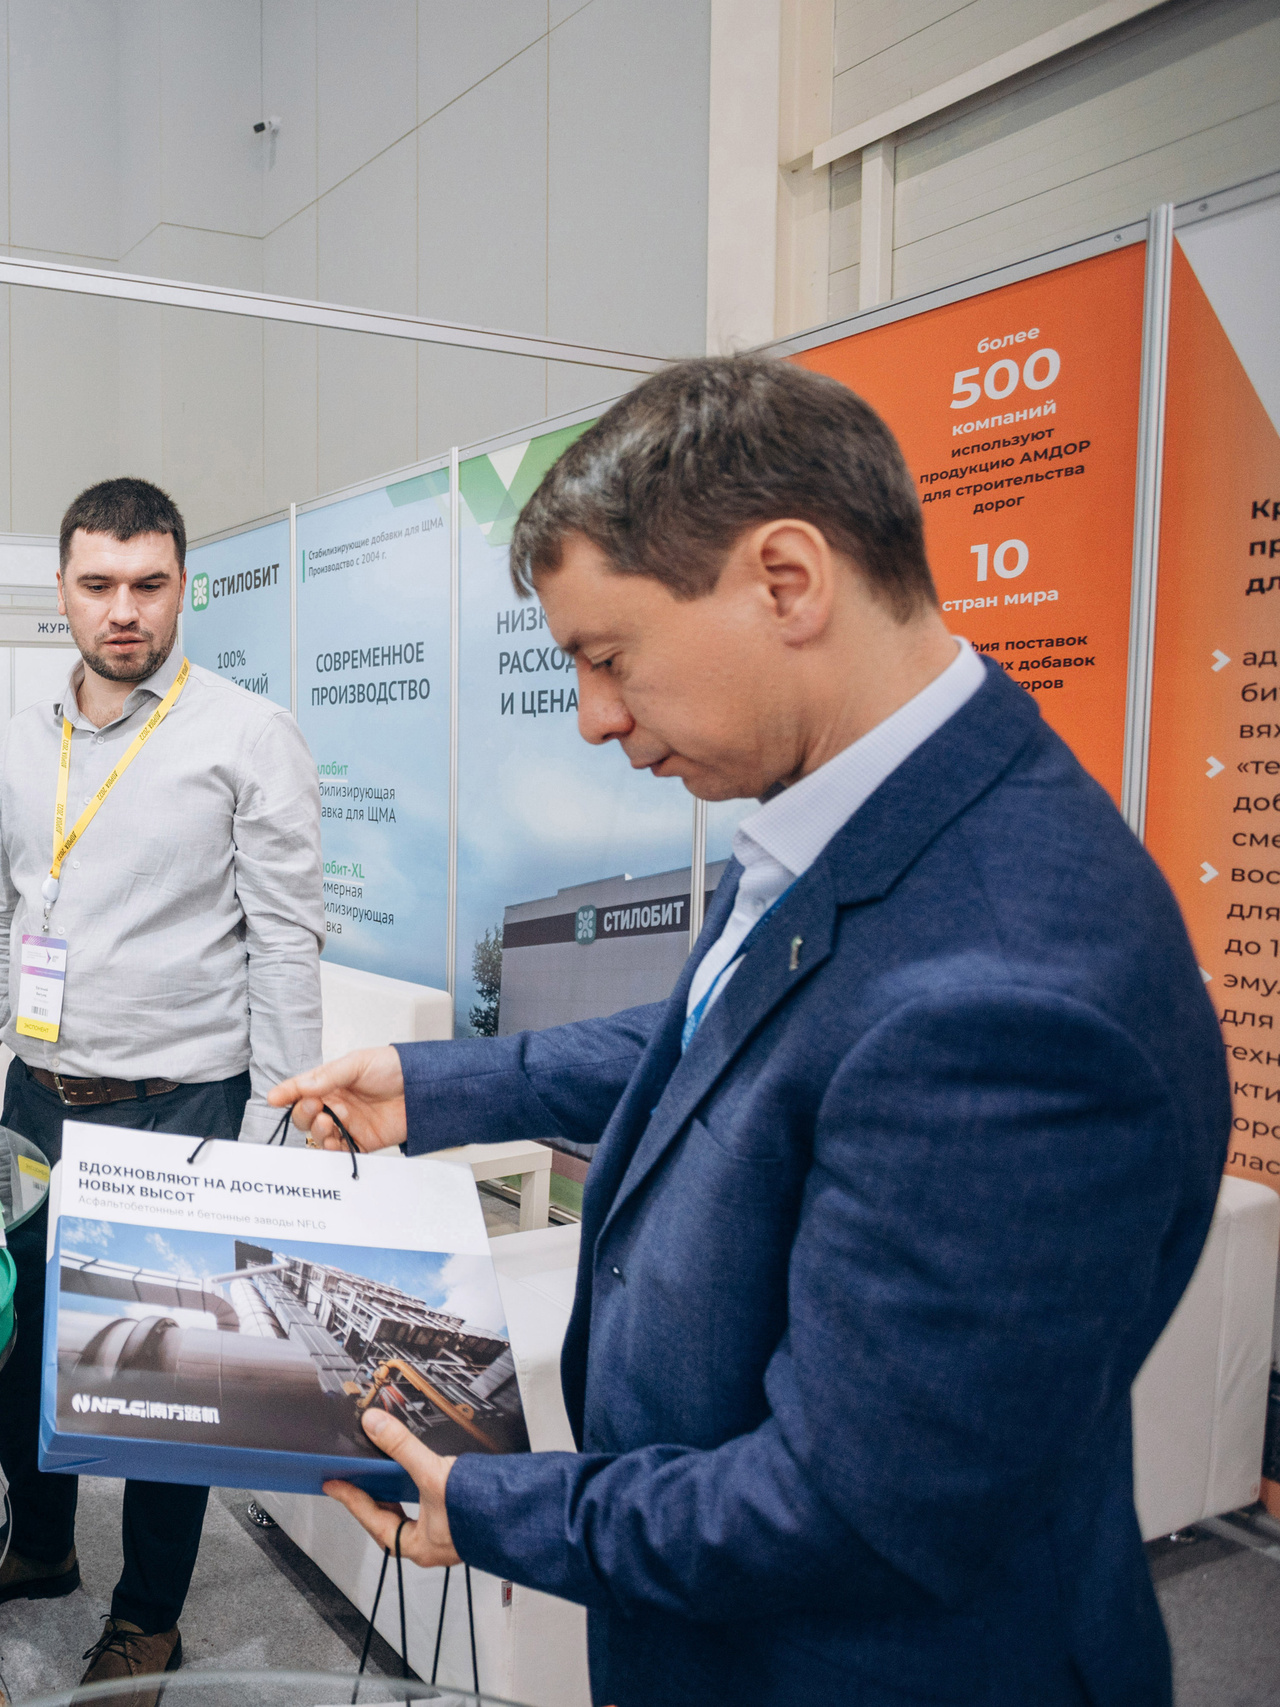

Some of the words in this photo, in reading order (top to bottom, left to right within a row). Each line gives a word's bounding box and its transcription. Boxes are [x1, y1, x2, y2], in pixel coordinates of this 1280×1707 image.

[977, 327, 1040, 354] более
[950, 348, 1061, 409] 500
[952, 399, 1057, 436] компаний
[951, 428, 1055, 458] используют
[920, 457, 1015, 484] продукцию
[1019, 440, 1091, 465] АМДОР
[922, 489, 951, 504] для
[956, 464, 1085, 496] строительства
[973, 496, 1025, 514] дорог
[308, 538, 369, 560] Стабилизирующие
[371, 530, 403, 546] добавки
[404, 525, 420, 537] для
[421, 517, 444, 533] ЩМА
[308, 559, 354, 578] Производство
[362, 550, 380, 565] 2004
[970, 539, 1029, 582] 10
[212, 563, 280, 598] СТИЛОБИТ
[942, 596, 998, 613] стран
[1004, 589, 1059, 606] мира
[1005, 635, 1088, 651] поставок
[217, 649, 246, 669] 100%
[316, 641, 424, 673] СОВРЕМЕННОЕ
[1018, 656, 1095, 672] добавок
[1243, 650, 1278, 668] ад
[311, 678, 430, 706] ПРОИЗВОДСТВО
[501, 692, 514, 715] И
[522, 688, 578, 718] ЦЕНА
[1241, 682, 1280, 702] би
[346, 808, 364, 821] для
[367, 806, 396, 823] ЩМА
[604, 901, 684, 932] СТИЛОБИТ
[1227, 904, 1280, 921] для
[1225, 939, 1261, 956] до
[1223, 973, 1280, 997] эму
[1221, 1009, 1273, 1029] для
[1229, 1151, 1280, 1176] лас
[79, 1161, 200, 1187] ВДОХНОВЛЯЮТ
[204, 1177, 226, 1190] НА
[230, 1180, 342, 1201] ДОСТИЖЕНИЕ
[79, 1178, 135, 1196] НОВЫХ
[140, 1186, 195, 1203] ВЫСОТ
[79, 1195, 184, 1216] Асфальтобетонные
[187, 1209, 194, 1217] и
[197, 1209, 251, 1223] бетонные
[254, 1217, 294, 1228] заводы
[297, 1219, 327, 1230] NFLG
[91, 1396, 146, 1418] NFLG
